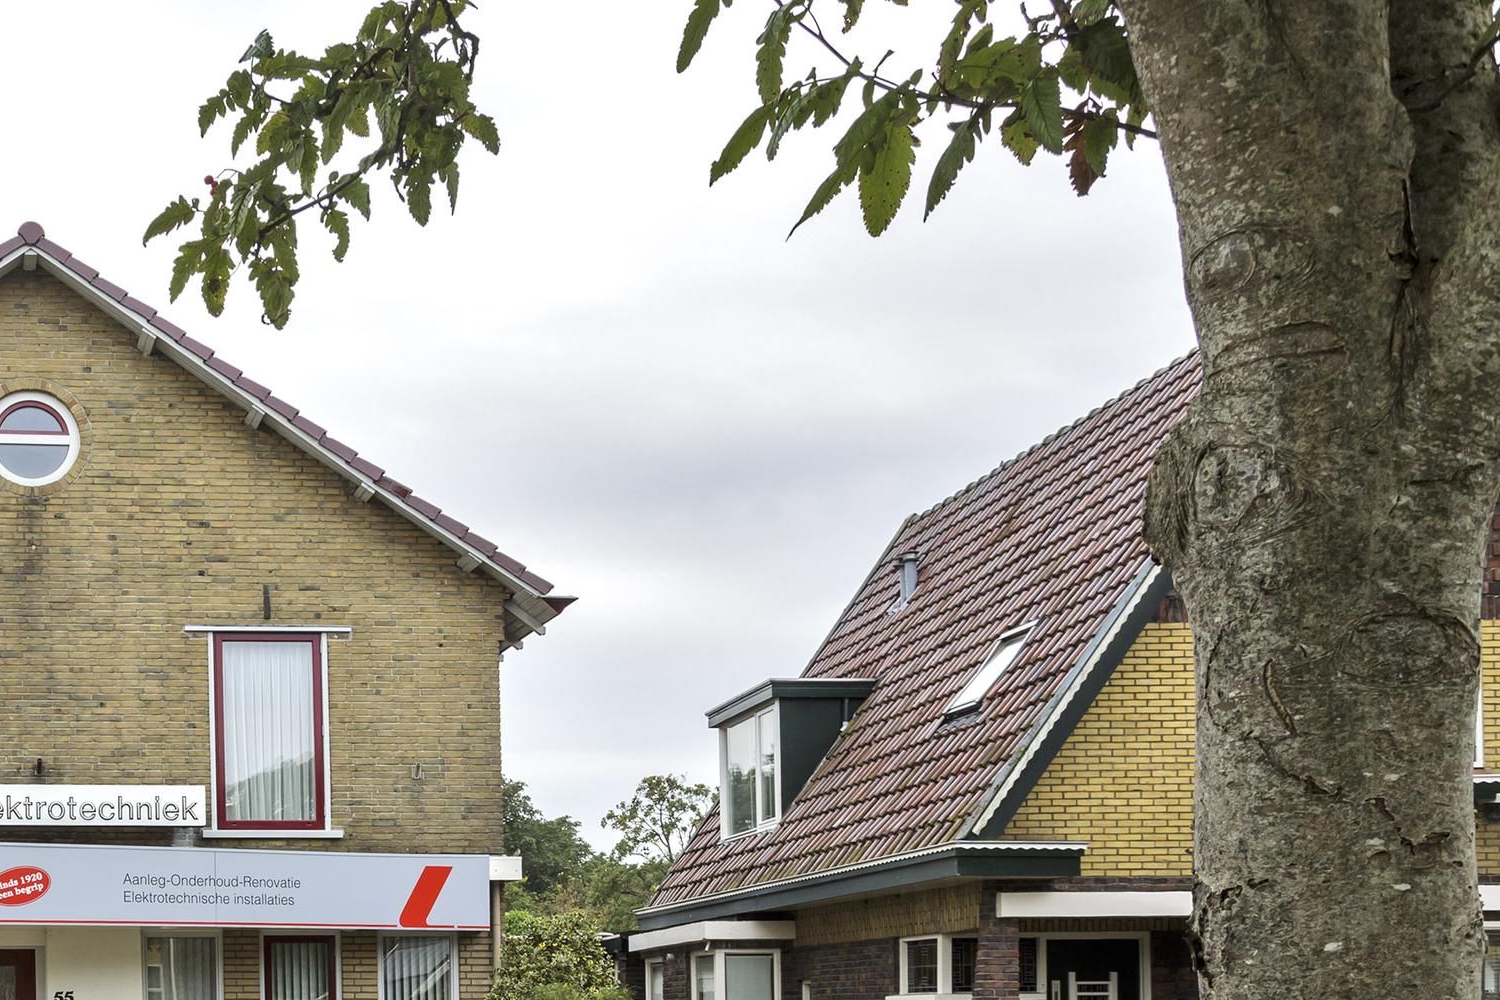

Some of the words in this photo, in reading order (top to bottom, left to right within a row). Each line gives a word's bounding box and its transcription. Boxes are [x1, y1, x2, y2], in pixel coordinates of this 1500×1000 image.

[20, 872, 43, 885] 1920
[122, 873, 301, 889] Aanleg-Onderhoud-Renovatie
[14, 883, 44, 896] begrip
[123, 890, 231, 905] Elektrotechnische
[233, 893, 296, 906] installaties
